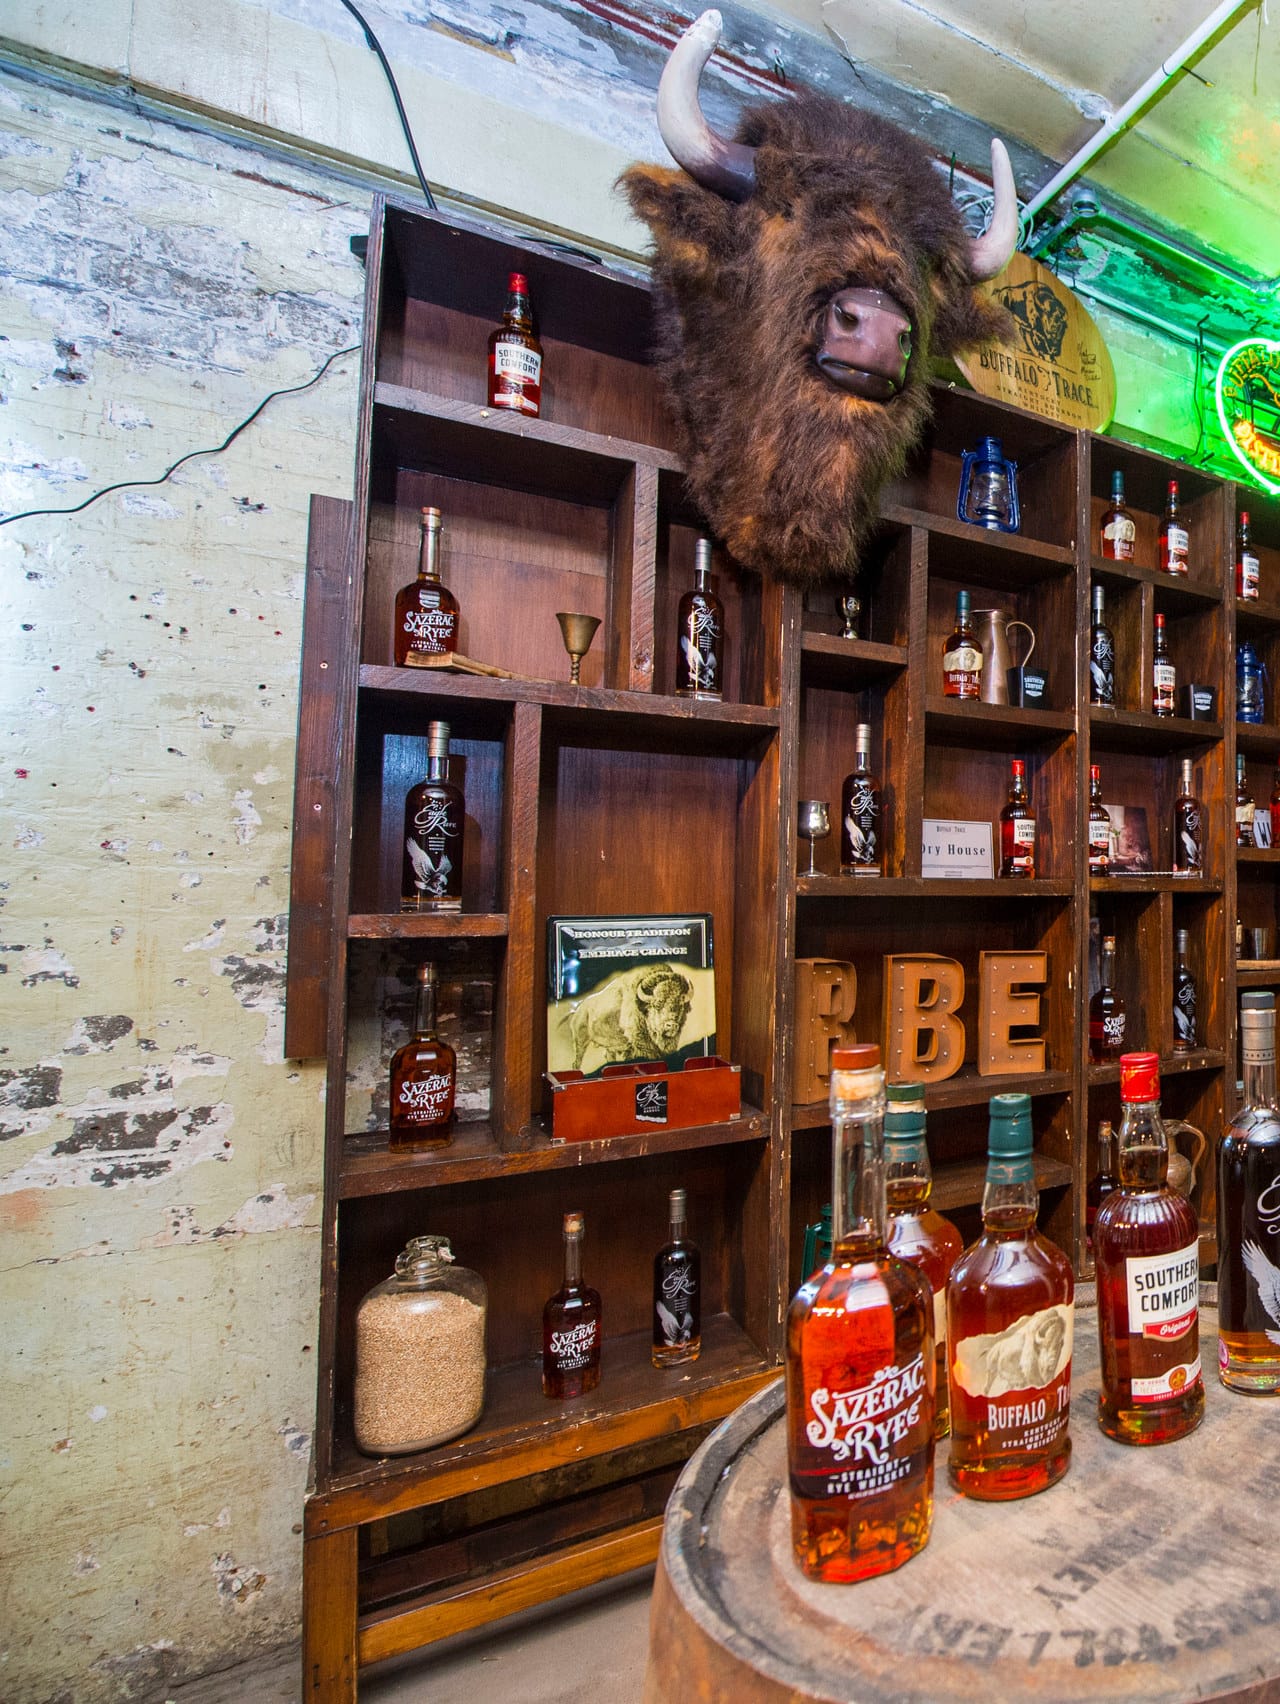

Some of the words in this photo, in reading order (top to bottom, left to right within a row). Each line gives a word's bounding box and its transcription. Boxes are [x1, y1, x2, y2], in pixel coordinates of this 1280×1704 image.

[498, 349, 540, 368] SOUTHERN
[500, 358, 537, 375] COMFORT
[980, 350, 1039, 387] BUFFALO
[1053, 371, 1098, 409] TRACE
[403, 611, 454, 632] SAZERAC
[413, 625, 453, 642] RYE
[948, 844, 986, 856] House
[574, 930, 626, 940] HONOUR
[626, 928, 691, 938] TRADITION
[578, 949, 639, 959] EMBRACE
[640, 947, 688, 957] CHANGE
[400, 1076, 451, 1103] SAZERAC
[1141, 1278, 1198, 1312] COMFORT
[1159, 1316, 1191, 1336] Original
[550, 1321, 597, 1353] SAZERAC
[806, 1360, 926, 1448] SAZERAC
[987, 1397, 1046, 1432] BUFFALO
[831, 1394, 924, 1465] RYE
[1023, 1416, 1061, 1438] KENTUCKY
[1002, 1432, 1044, 1449] STRAIGHT
[1026, 1432, 1058, 1451] WHISKEY
[827, 1482, 851, 1494] RYE
[858, 1462, 912, 1491] WHISKEY
[840, 1457, 901, 1483] STRAIGHT
